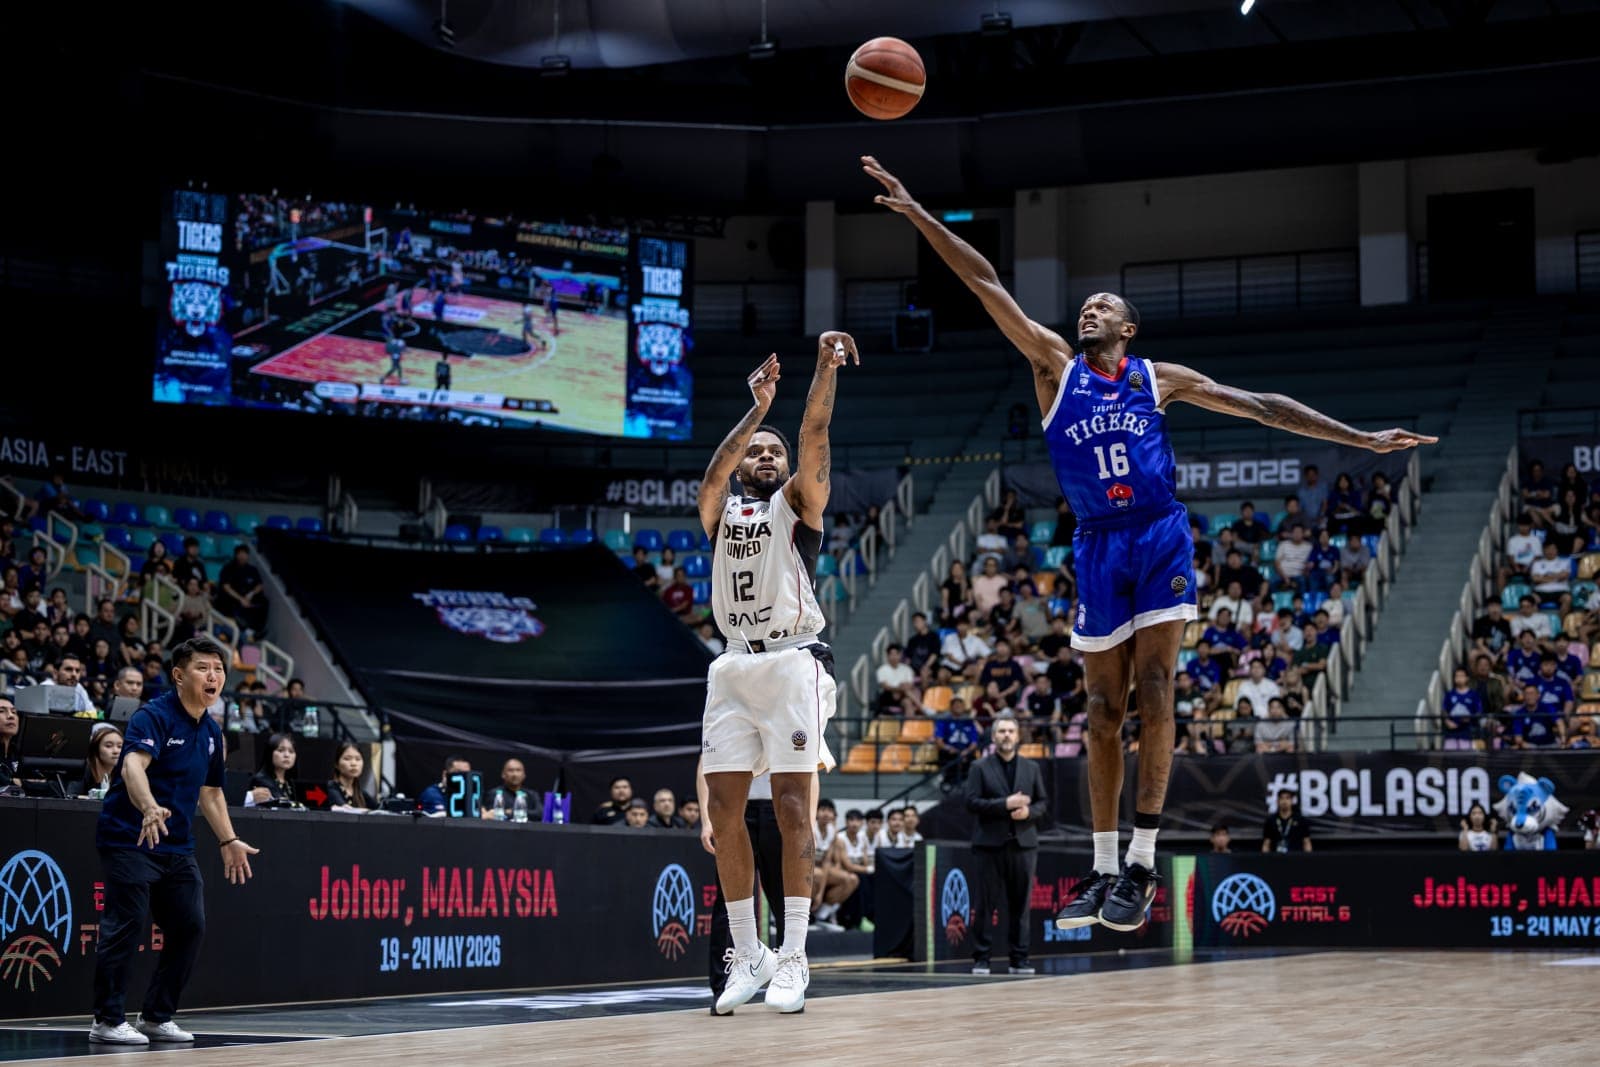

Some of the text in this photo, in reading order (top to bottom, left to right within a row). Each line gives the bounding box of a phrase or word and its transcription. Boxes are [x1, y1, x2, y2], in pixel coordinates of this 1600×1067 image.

[165, 261, 230, 286] TIGERS
[1064, 412, 1149, 445] TIGERS
[1, 436, 49, 468] ASIA
[71, 446, 127, 477] EAST
[1094, 442, 1130, 480] 16
[1175, 459, 1301, 489] OR 2026
[606, 479, 702, 506] #BCLAS
[726, 540, 762, 560] UNIED
[732, 571, 756, 602] 12
[1265, 766, 1492, 817] #BCLASIA
[309, 864, 559, 927] Johor, MALAYSIA
[1290, 886, 1337, 903] EAST
[1413, 876, 1528, 912] Johor,
[1281, 905, 1351, 922] FINAL 6
[1490, 916, 1513, 937] 19
[1527, 915, 1550, 937] 24
[1553, 915, 1591, 937] MAY
[380, 937, 400, 971] 19
[412, 936, 431, 970] 24
[434, 935, 464, 969] MAY
[466, 934, 501, 968] 2026
